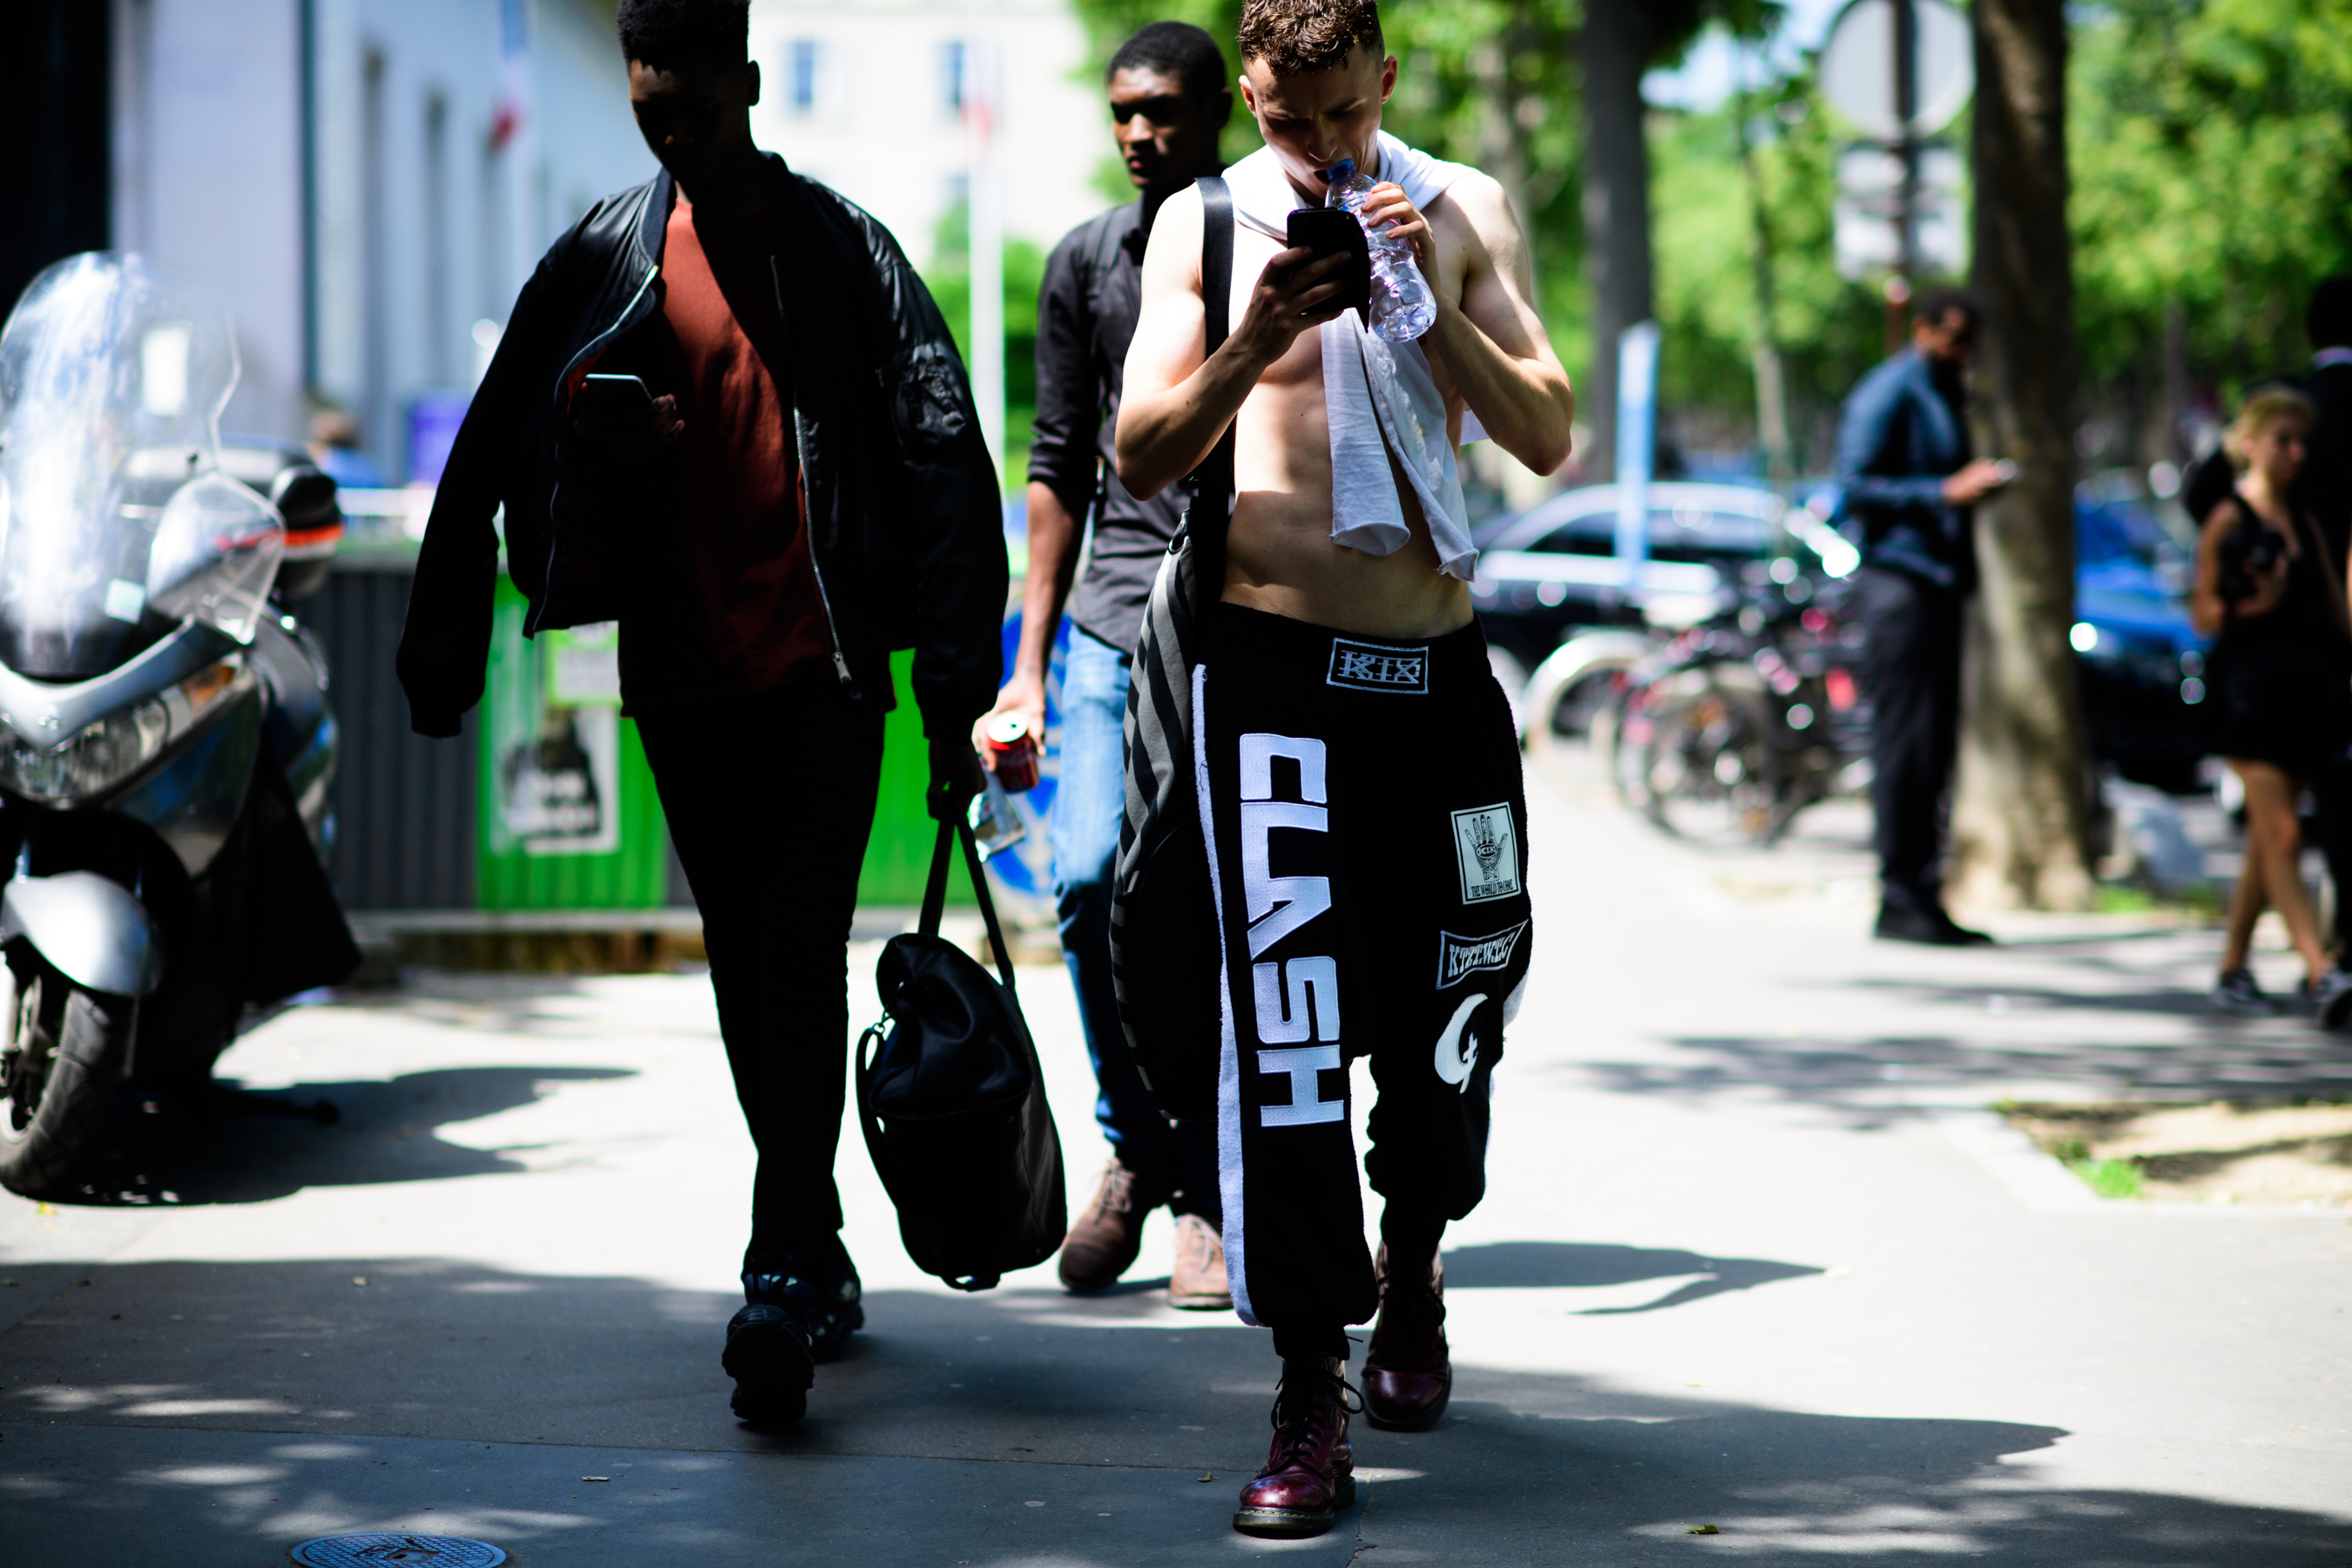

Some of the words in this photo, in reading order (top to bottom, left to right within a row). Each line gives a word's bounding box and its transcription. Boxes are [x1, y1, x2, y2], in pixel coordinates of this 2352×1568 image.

[1240, 733, 1344, 1126] CLASH
[1471, 885, 1481, 897] THE
[1480, 882, 1497, 896] WORLD
[1497, 881, 1504, 893] TO
